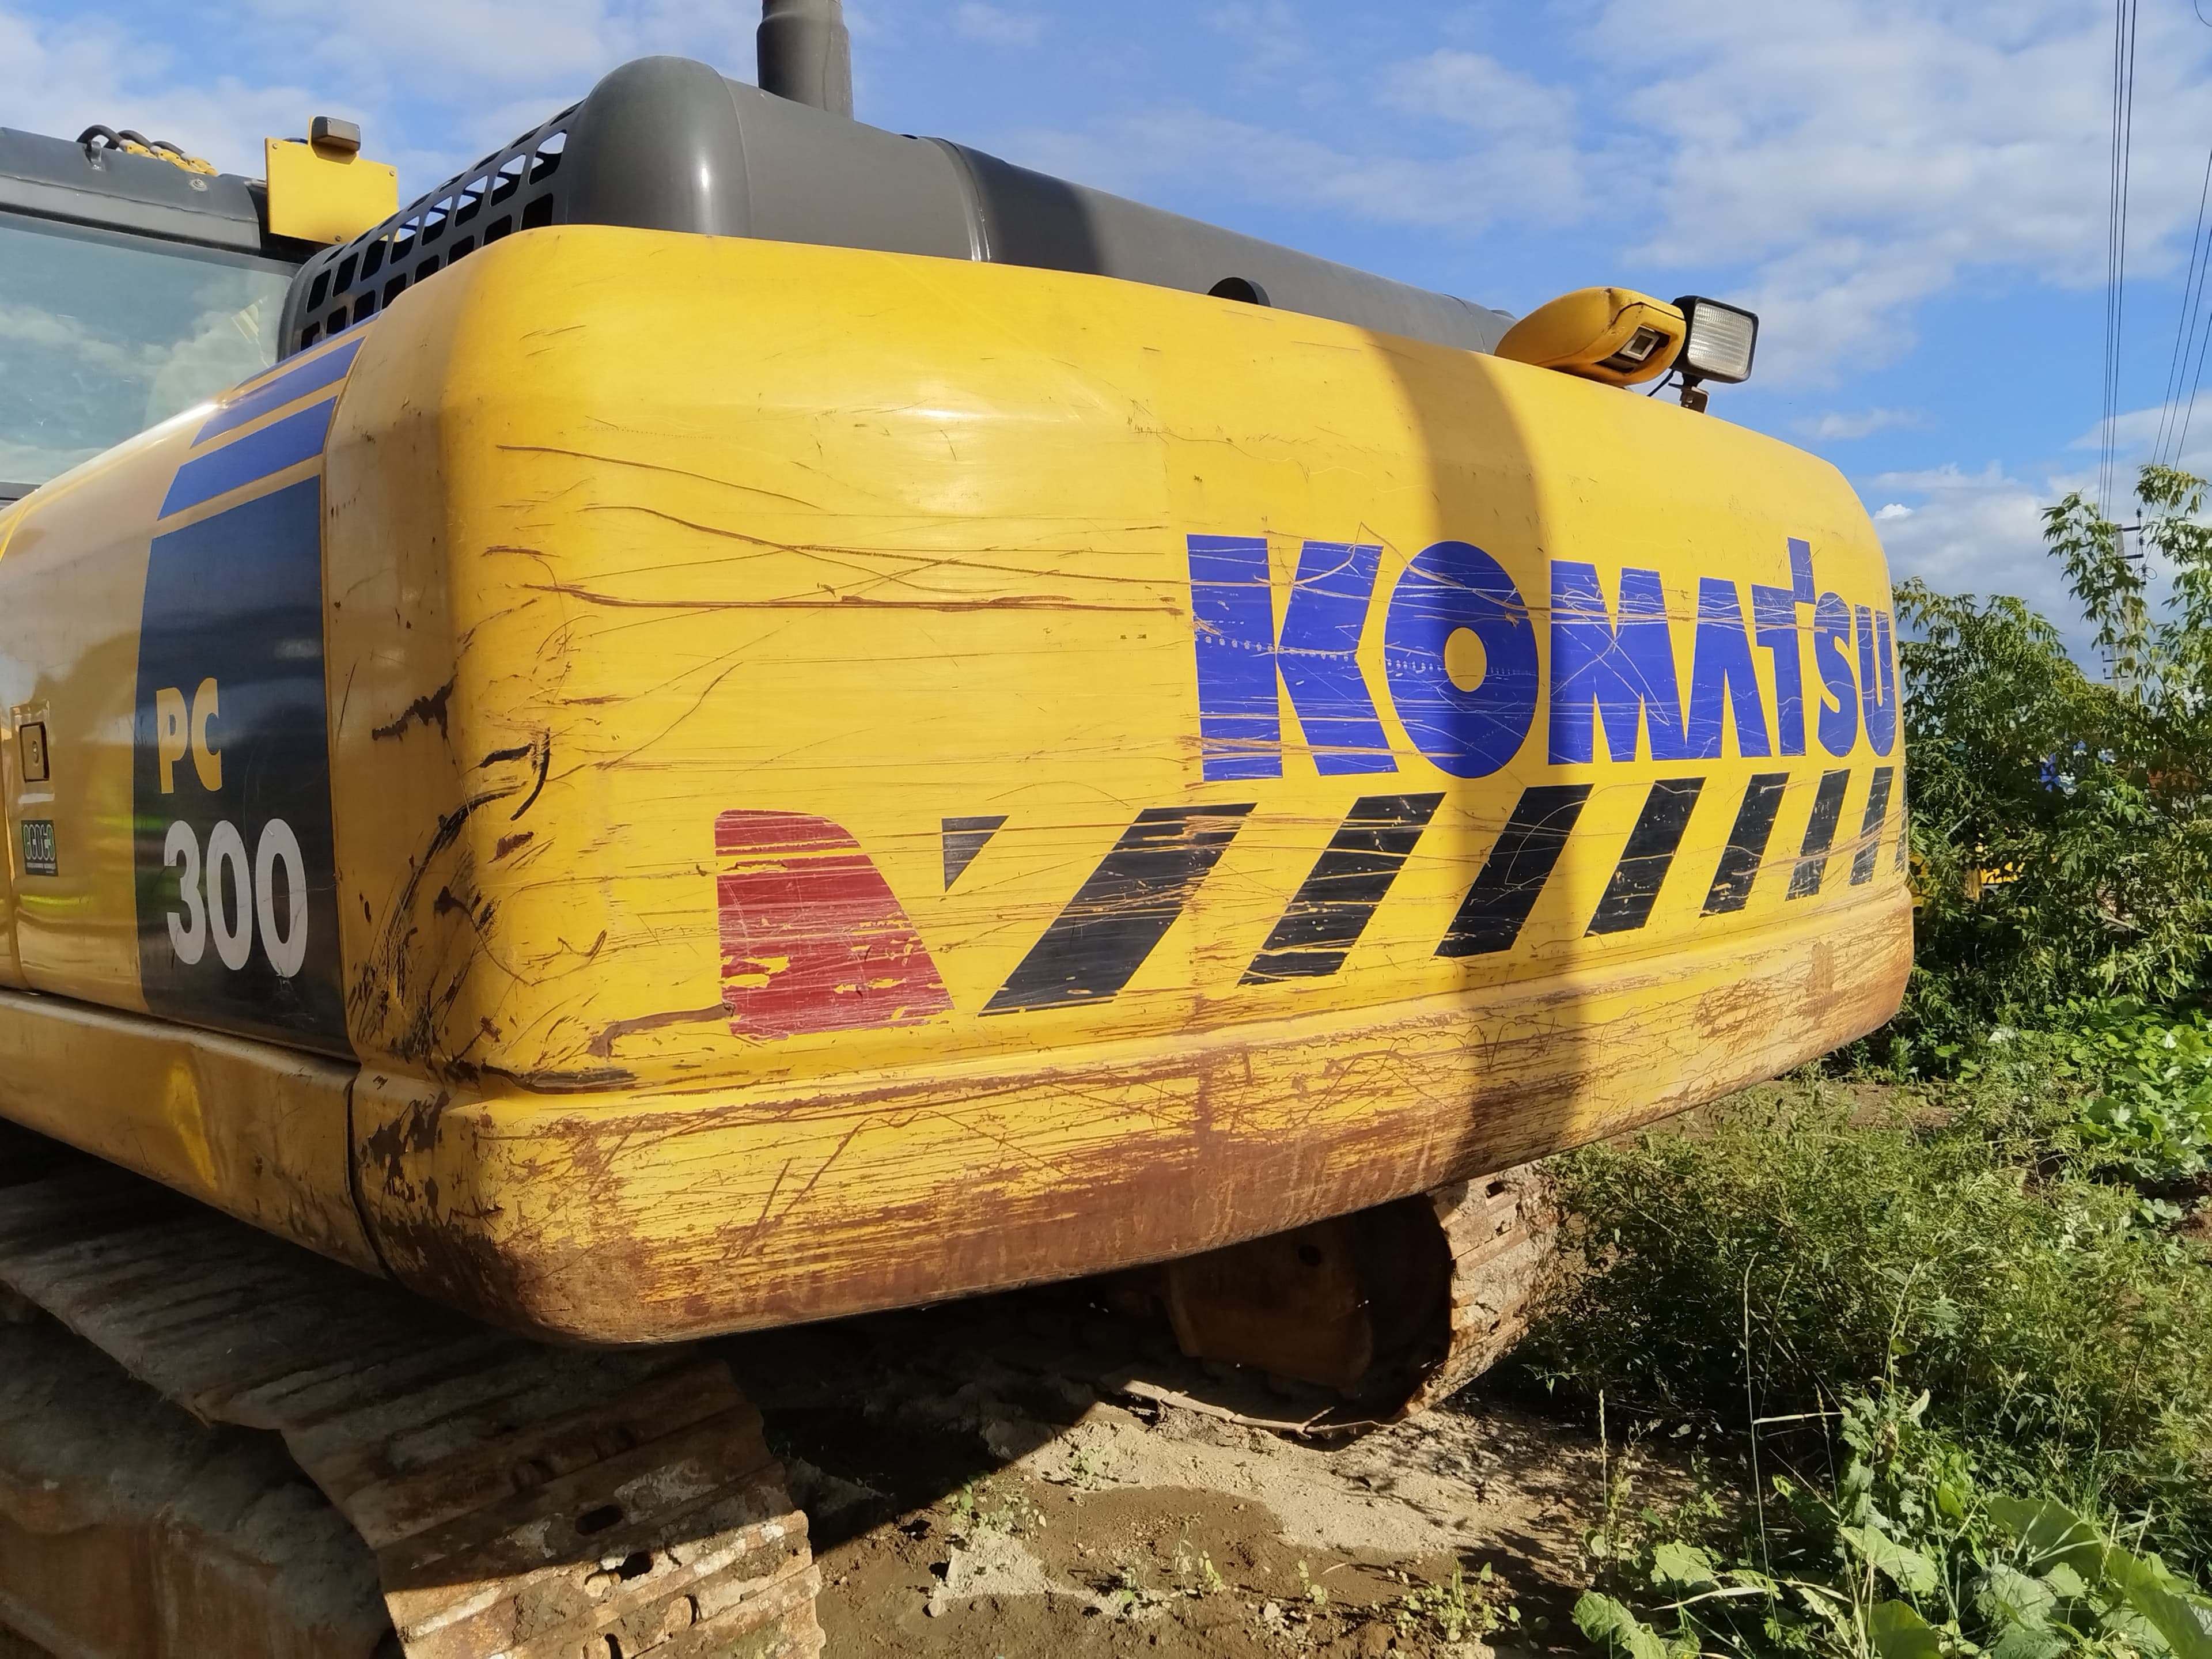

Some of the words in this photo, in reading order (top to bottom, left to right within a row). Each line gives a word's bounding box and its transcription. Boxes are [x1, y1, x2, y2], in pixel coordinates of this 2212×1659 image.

[156, 677, 222, 794] PC
[1187, 534, 1897, 782] KOMATSU
[164, 818, 308, 978] 300
